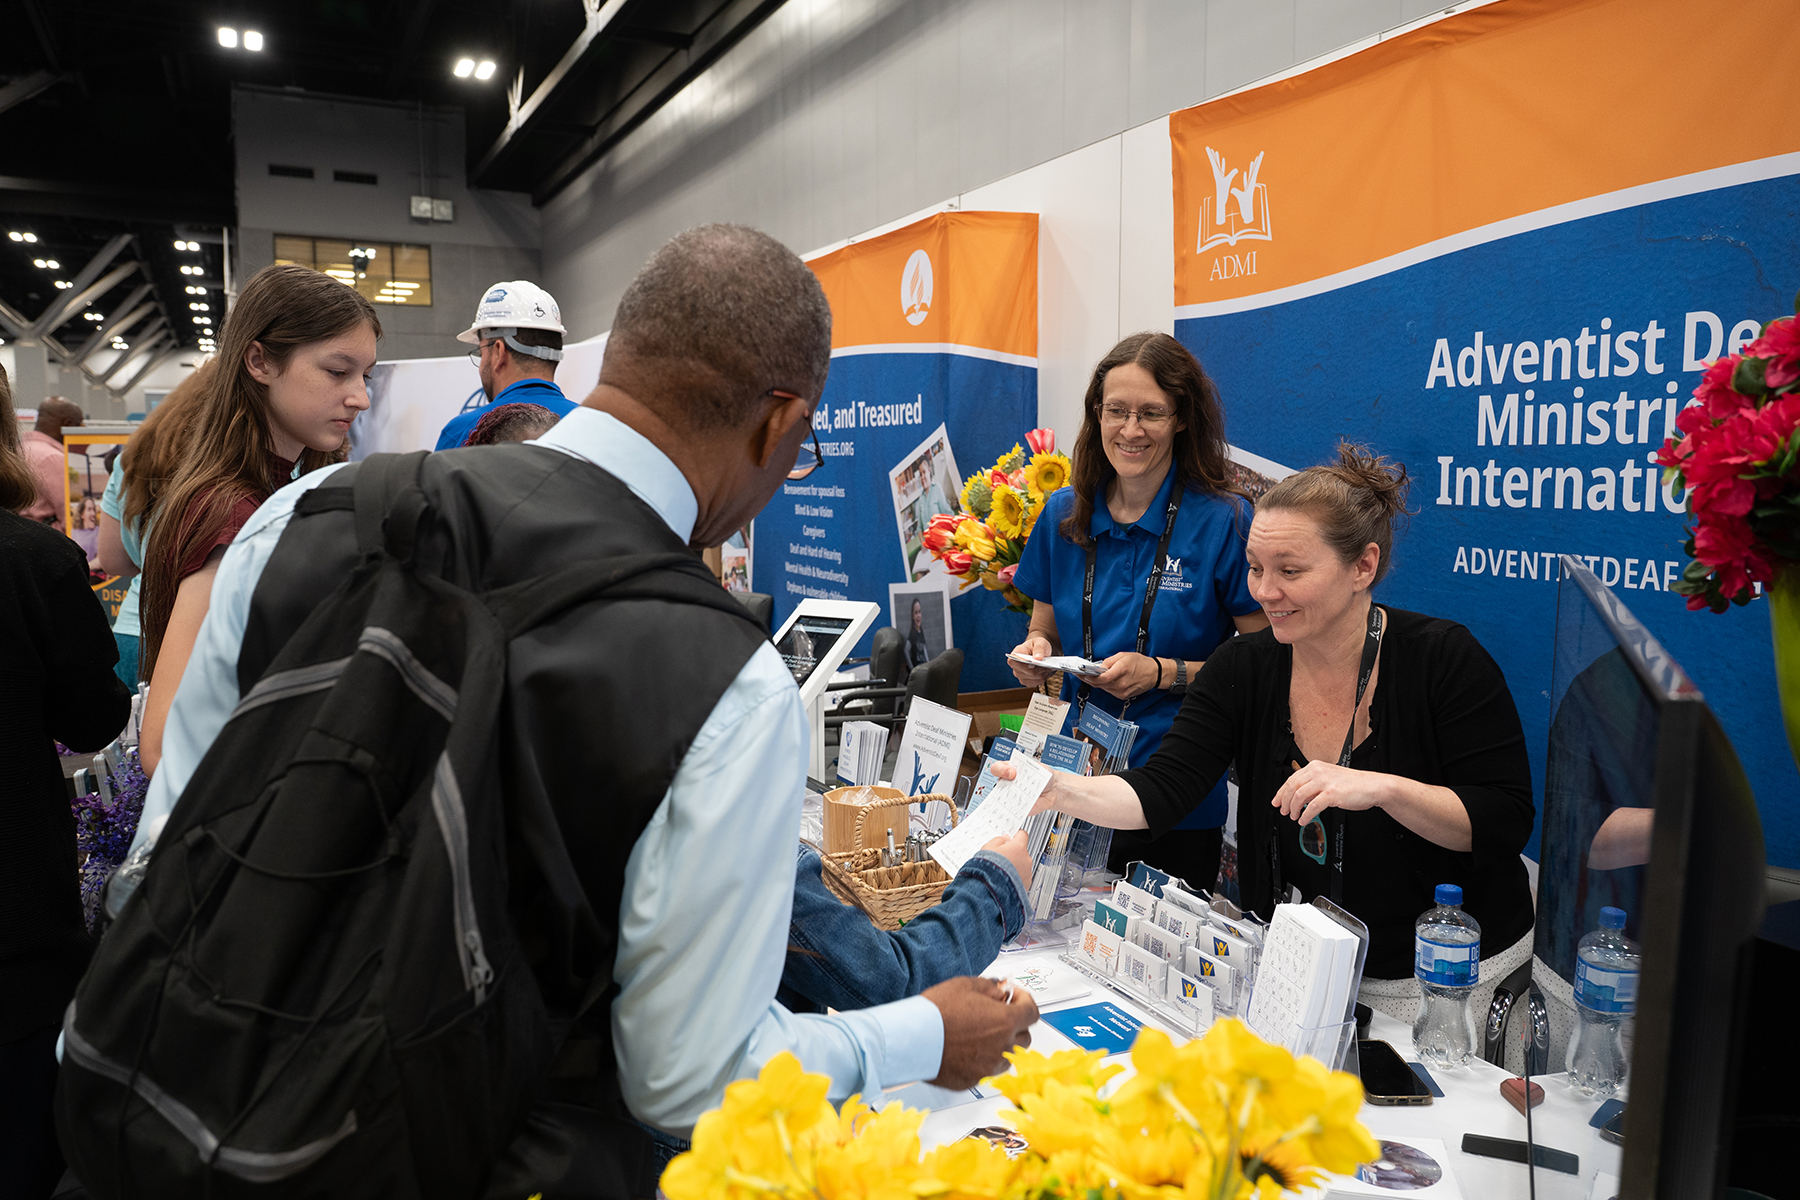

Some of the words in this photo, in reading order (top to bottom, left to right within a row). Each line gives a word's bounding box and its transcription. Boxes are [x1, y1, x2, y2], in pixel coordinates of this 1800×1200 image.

[1209, 251, 1257, 281] ADMI
[1425, 317, 1666, 389] Adventist
[834, 401, 856, 429] and
[857, 394, 923, 428] Treasured
[1477, 381, 1704, 446] Ministri
[819, 506, 833, 518] Vision
[803, 525, 826, 540] Caregivers
